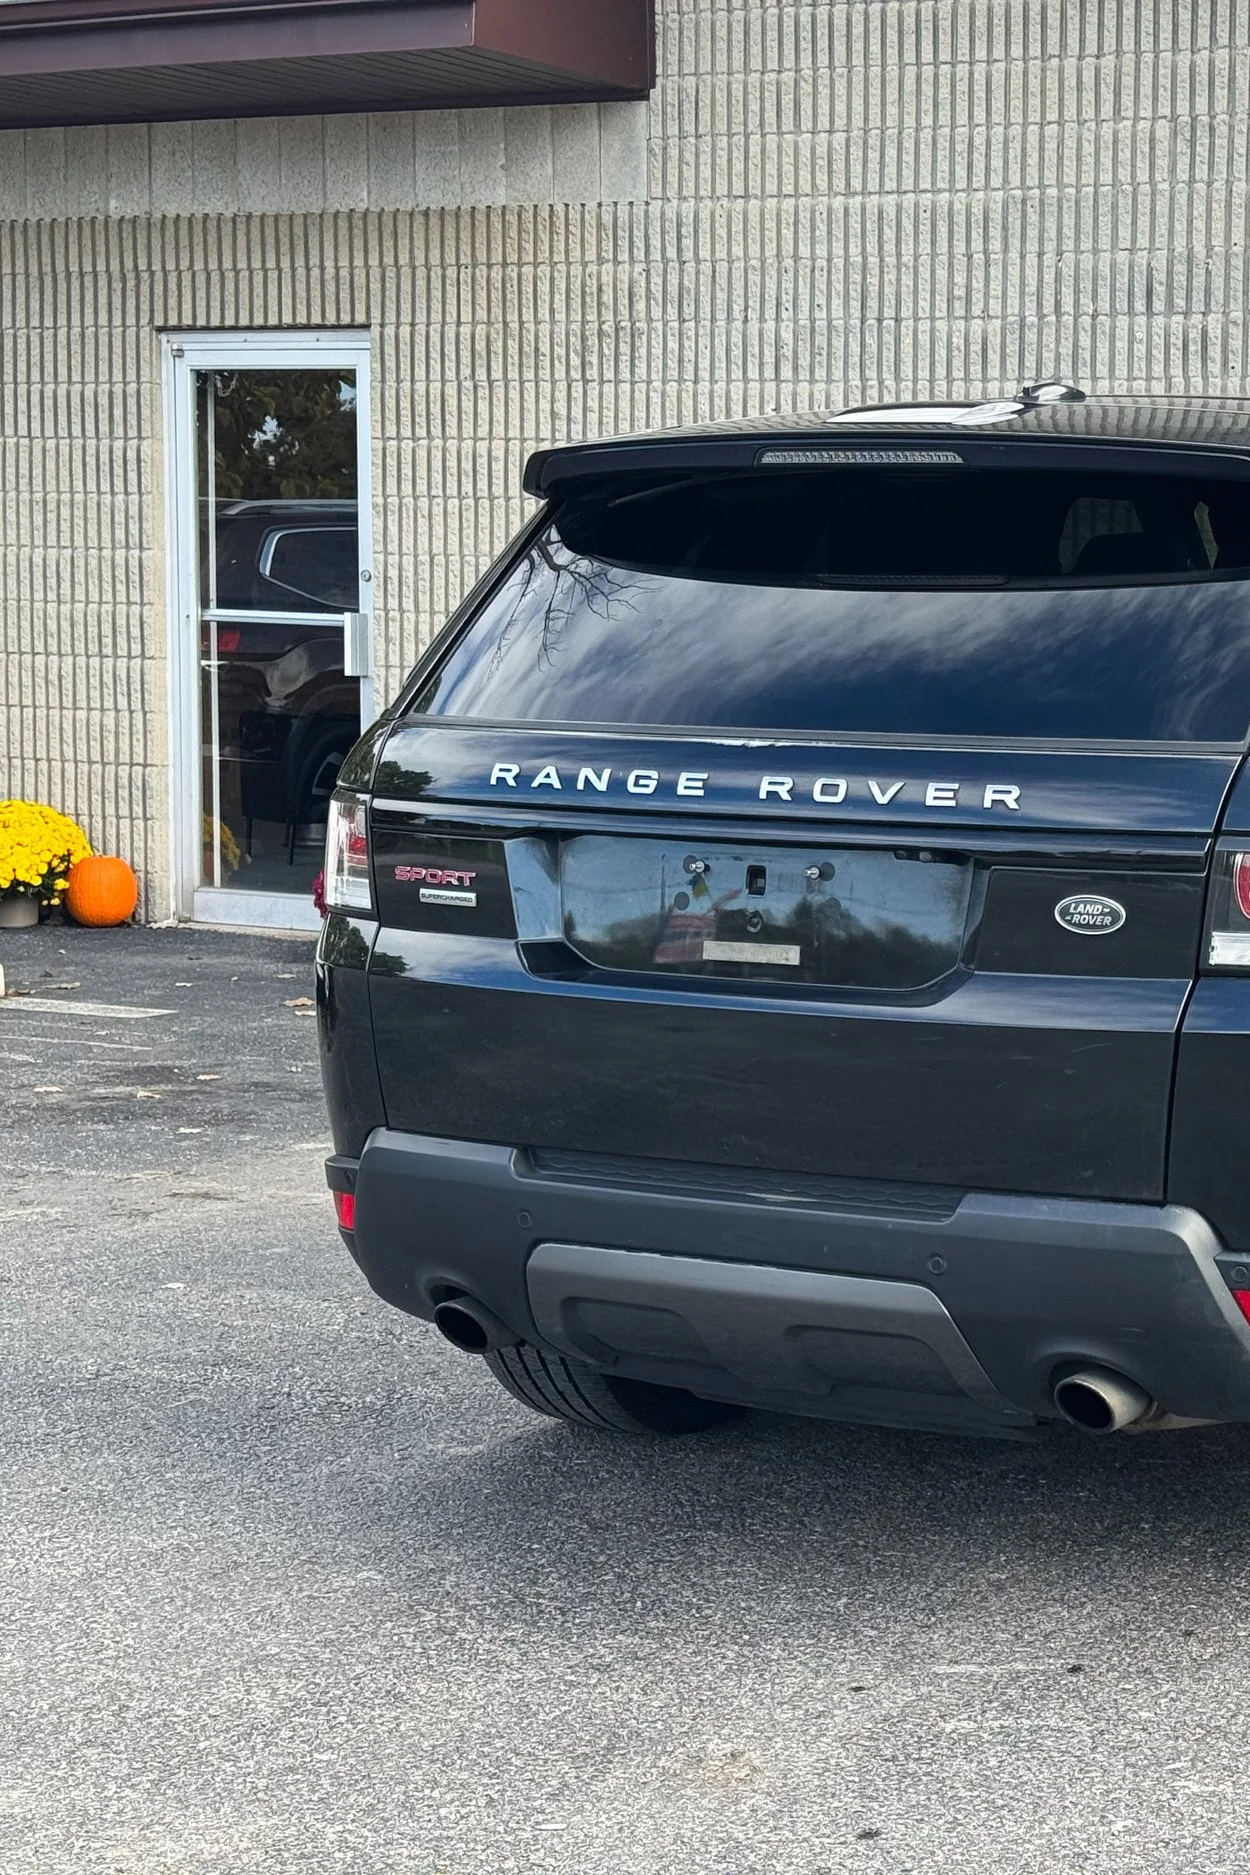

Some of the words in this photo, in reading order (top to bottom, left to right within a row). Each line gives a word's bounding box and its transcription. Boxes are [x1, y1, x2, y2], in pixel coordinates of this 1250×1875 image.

[489, 762, 709, 797] RANGE
[758, 775, 1022, 810] ROVER
[394, 865, 477, 887] SPORT
[420, 892, 474, 903] SUPERCHARGED
[1071, 913, 1113, 926] ROVER
